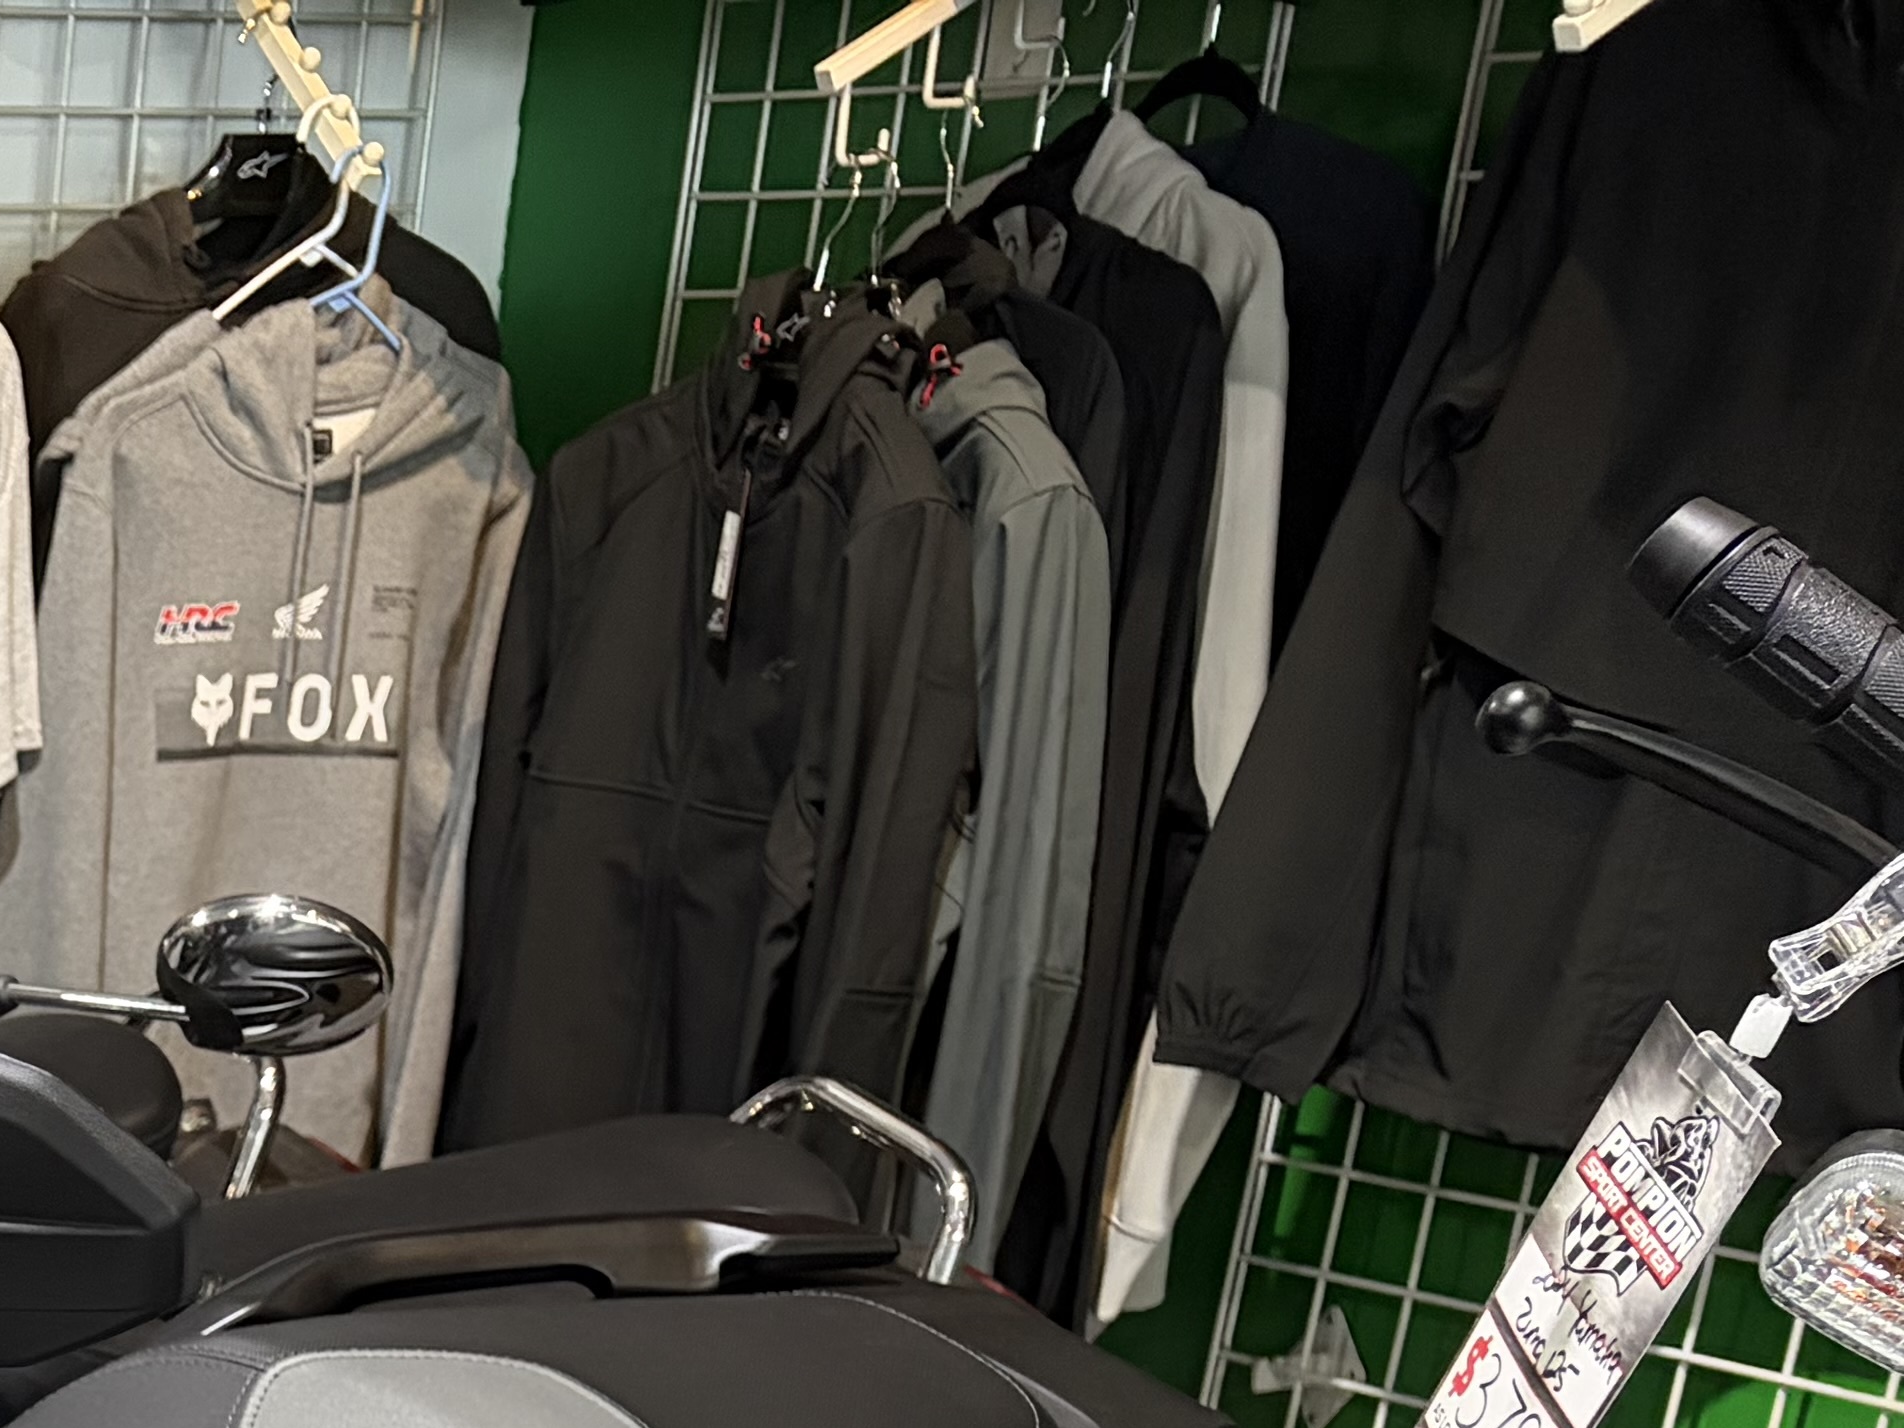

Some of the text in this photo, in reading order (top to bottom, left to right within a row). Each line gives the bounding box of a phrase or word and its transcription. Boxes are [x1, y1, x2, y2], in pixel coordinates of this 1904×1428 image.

[154, 601, 240, 642] HRC
[239, 673, 393, 741] FOX
[1583, 1156, 1675, 1280] SPORT CENTER
